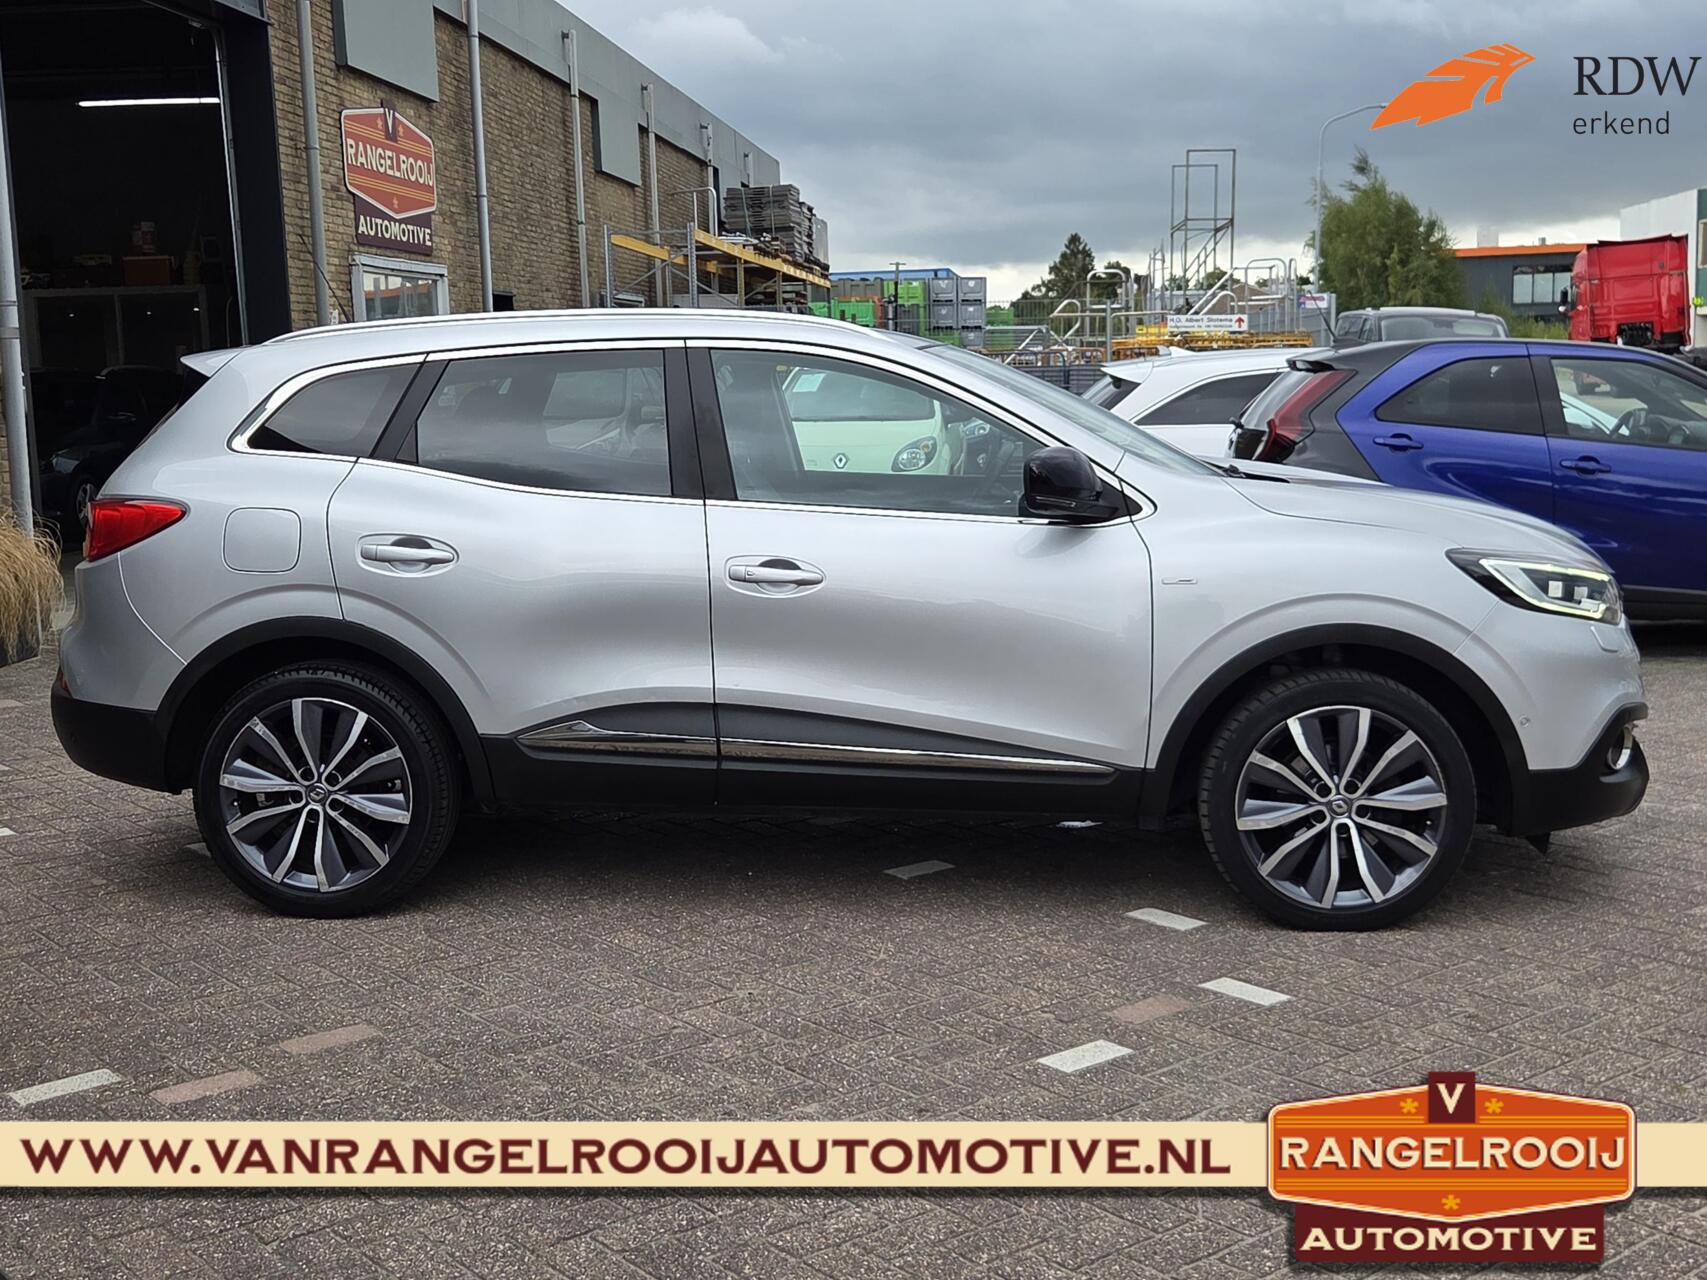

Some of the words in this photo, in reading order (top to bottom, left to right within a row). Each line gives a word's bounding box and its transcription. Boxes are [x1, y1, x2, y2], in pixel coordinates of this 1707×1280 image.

[385, 108, 396, 134] V
[347, 138, 433, 187] RANGELROOIJ
[358, 215, 432, 246] AUTOMOTIVE
